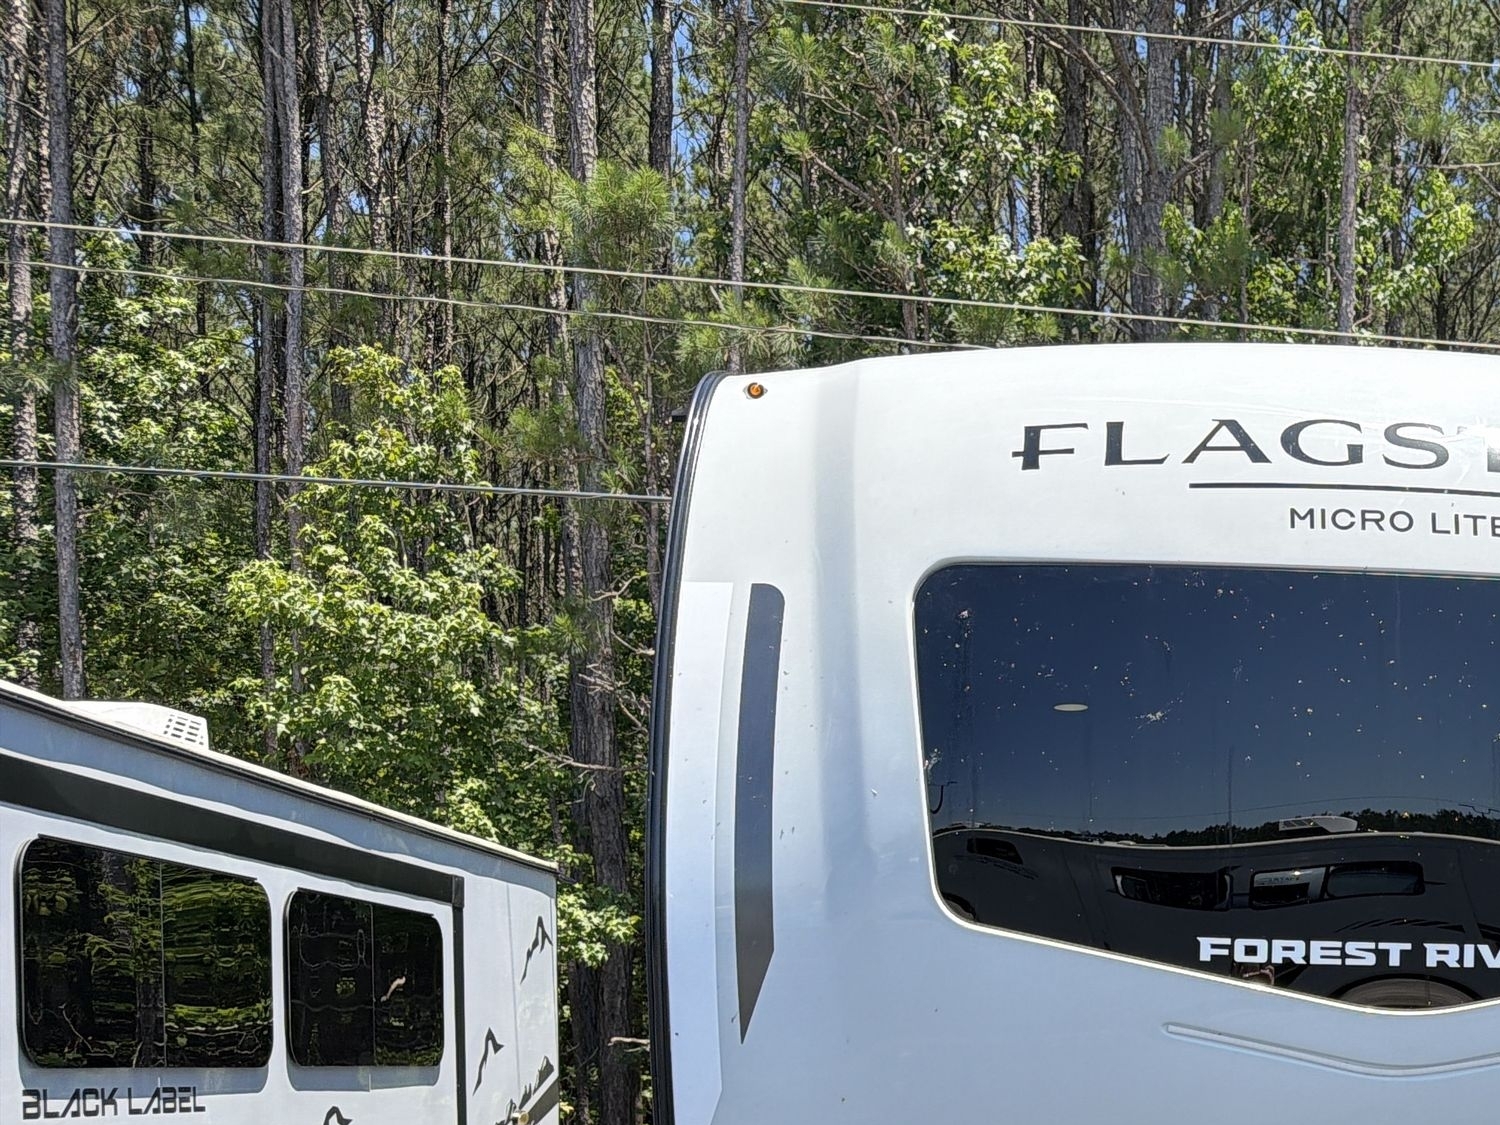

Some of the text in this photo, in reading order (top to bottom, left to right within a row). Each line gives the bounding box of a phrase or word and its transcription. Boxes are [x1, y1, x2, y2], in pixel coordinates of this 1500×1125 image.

[1290, 508, 1414, 533] MICRO
[1197, 937, 1411, 967] FOREST
[22, 1086, 206, 1120] BLACK LABEL
